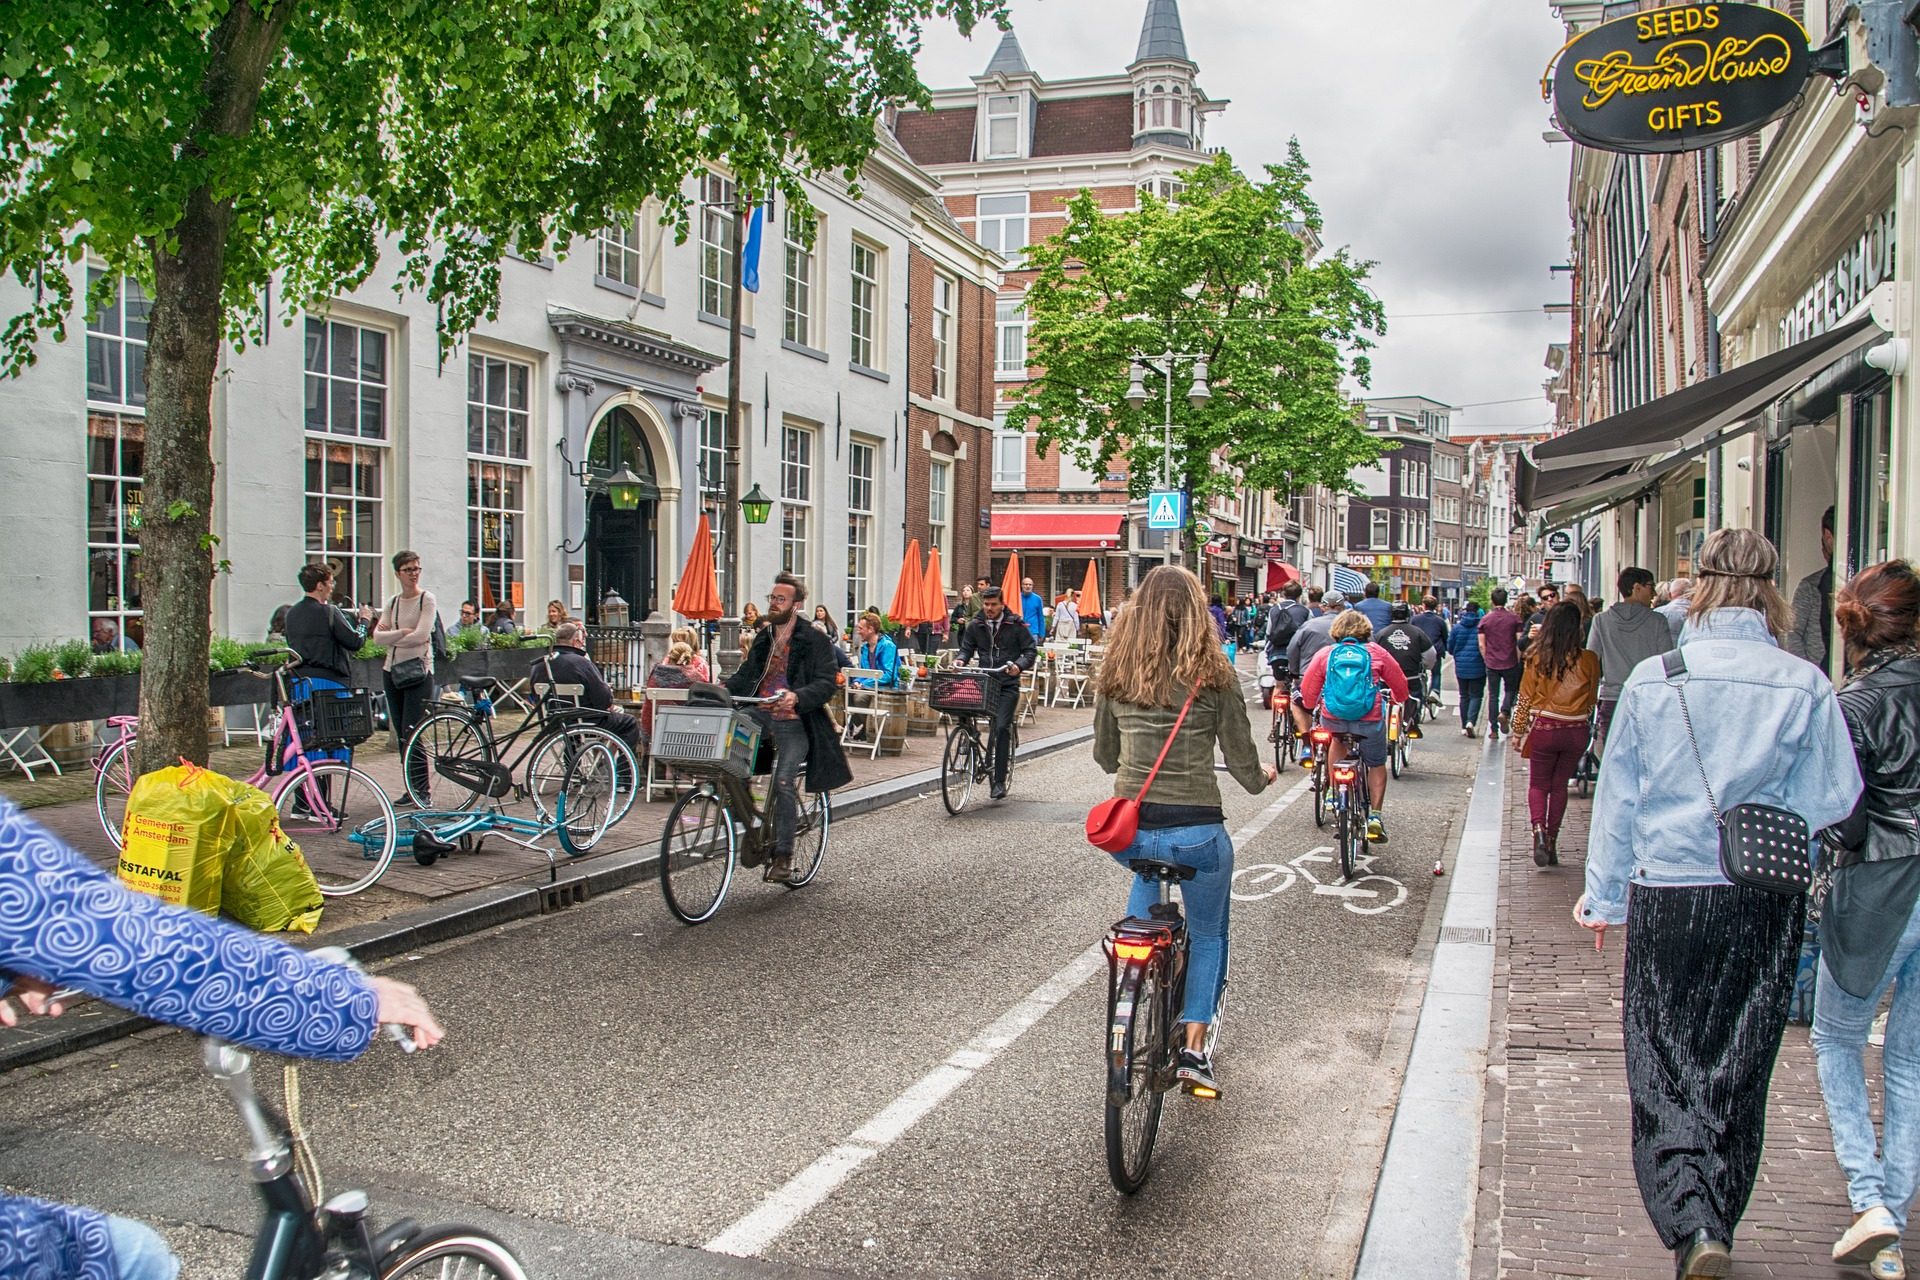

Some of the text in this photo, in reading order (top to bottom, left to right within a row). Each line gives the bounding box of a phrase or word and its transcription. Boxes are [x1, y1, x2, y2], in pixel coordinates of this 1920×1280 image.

[1636, 5, 1720, 41] SEEDS
[1648, 100, 1723, 131] GIFTS
[127, 489, 144, 504] STU
[134, 814, 185, 833] Gemeente
[133, 825, 189, 845] Amsterdam
